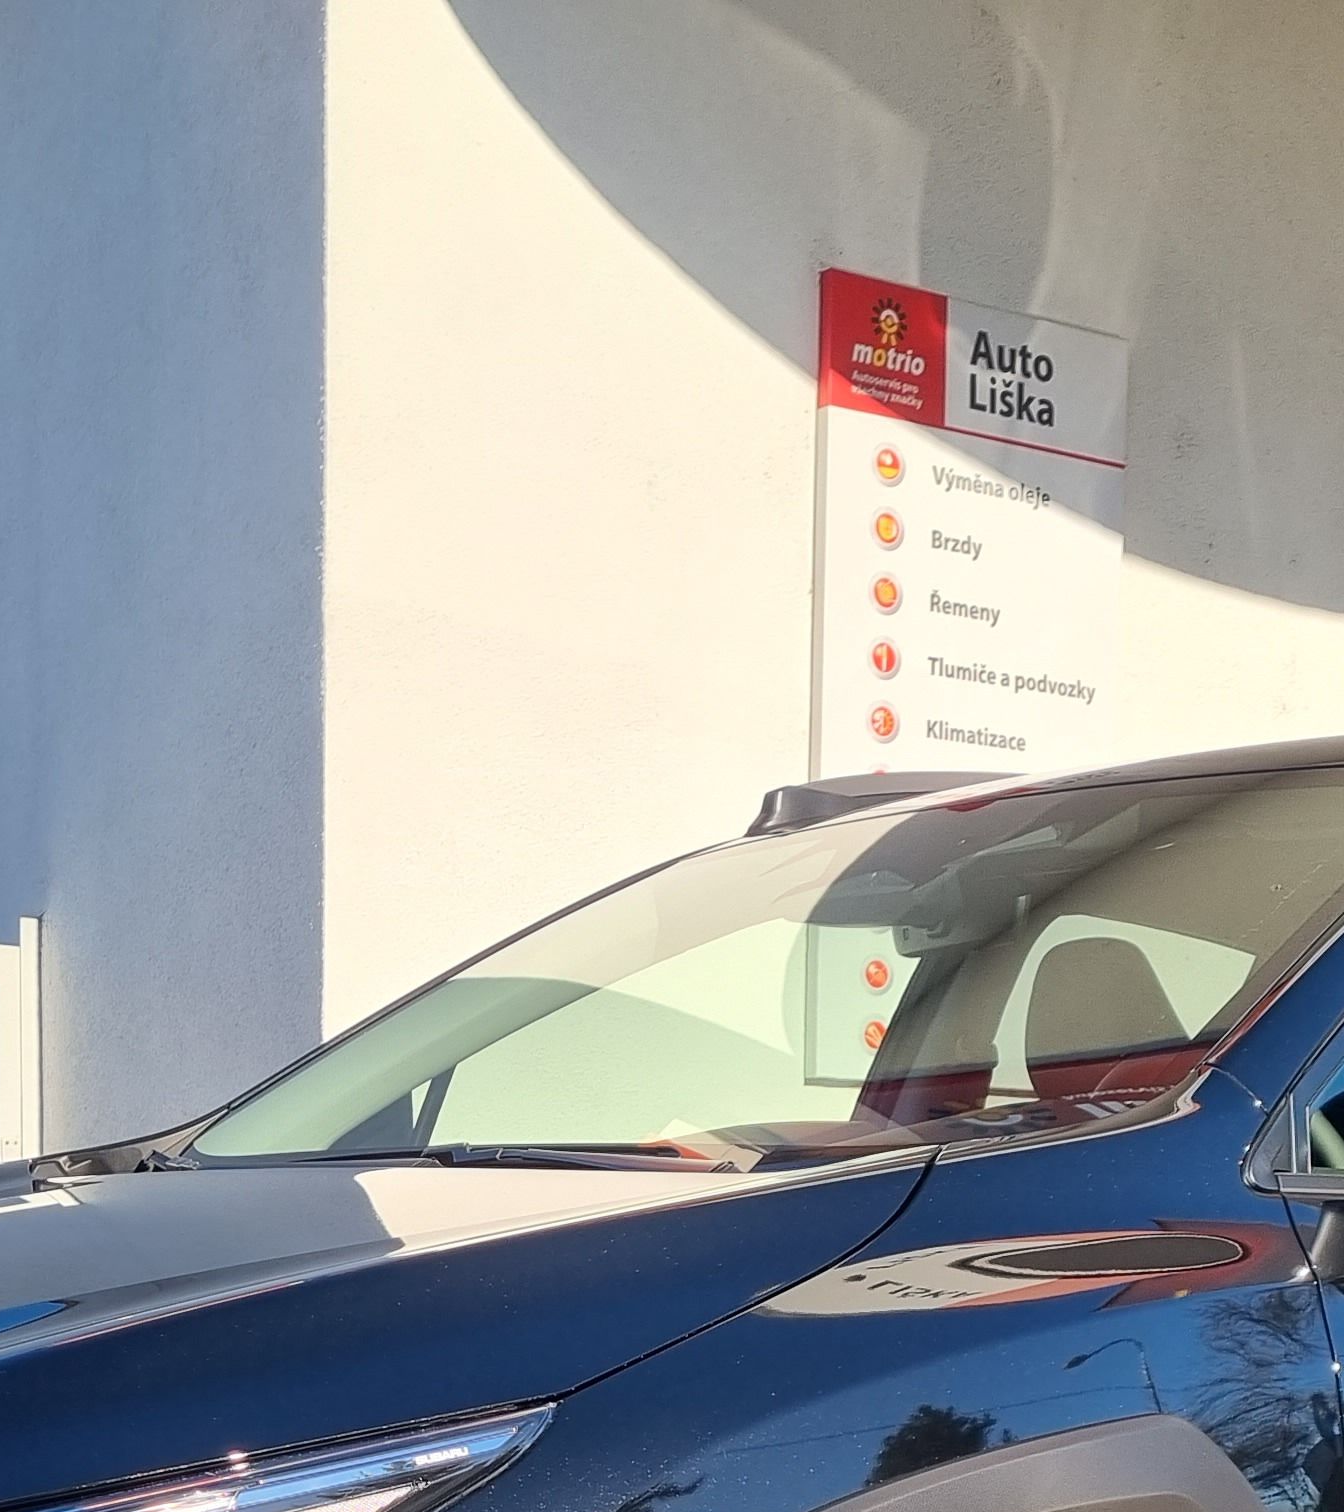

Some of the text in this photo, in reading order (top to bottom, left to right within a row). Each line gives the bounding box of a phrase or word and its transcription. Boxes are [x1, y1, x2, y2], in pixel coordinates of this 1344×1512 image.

[852, 343, 925, 376] motrio
[970, 330, 1053, 382] Auto
[970, 373, 1054, 427] Liška
[931, 464, 1051, 510] Výměna oleje
[931, 529, 983, 562] Brzdy
[929, 589, 1001, 628] Řemeny
[927, 656, 1096, 705] Tlumiče a podvozky
[926, 719, 1027, 751] Klimatizace
[414, 1446, 469, 1466] SUBARU
